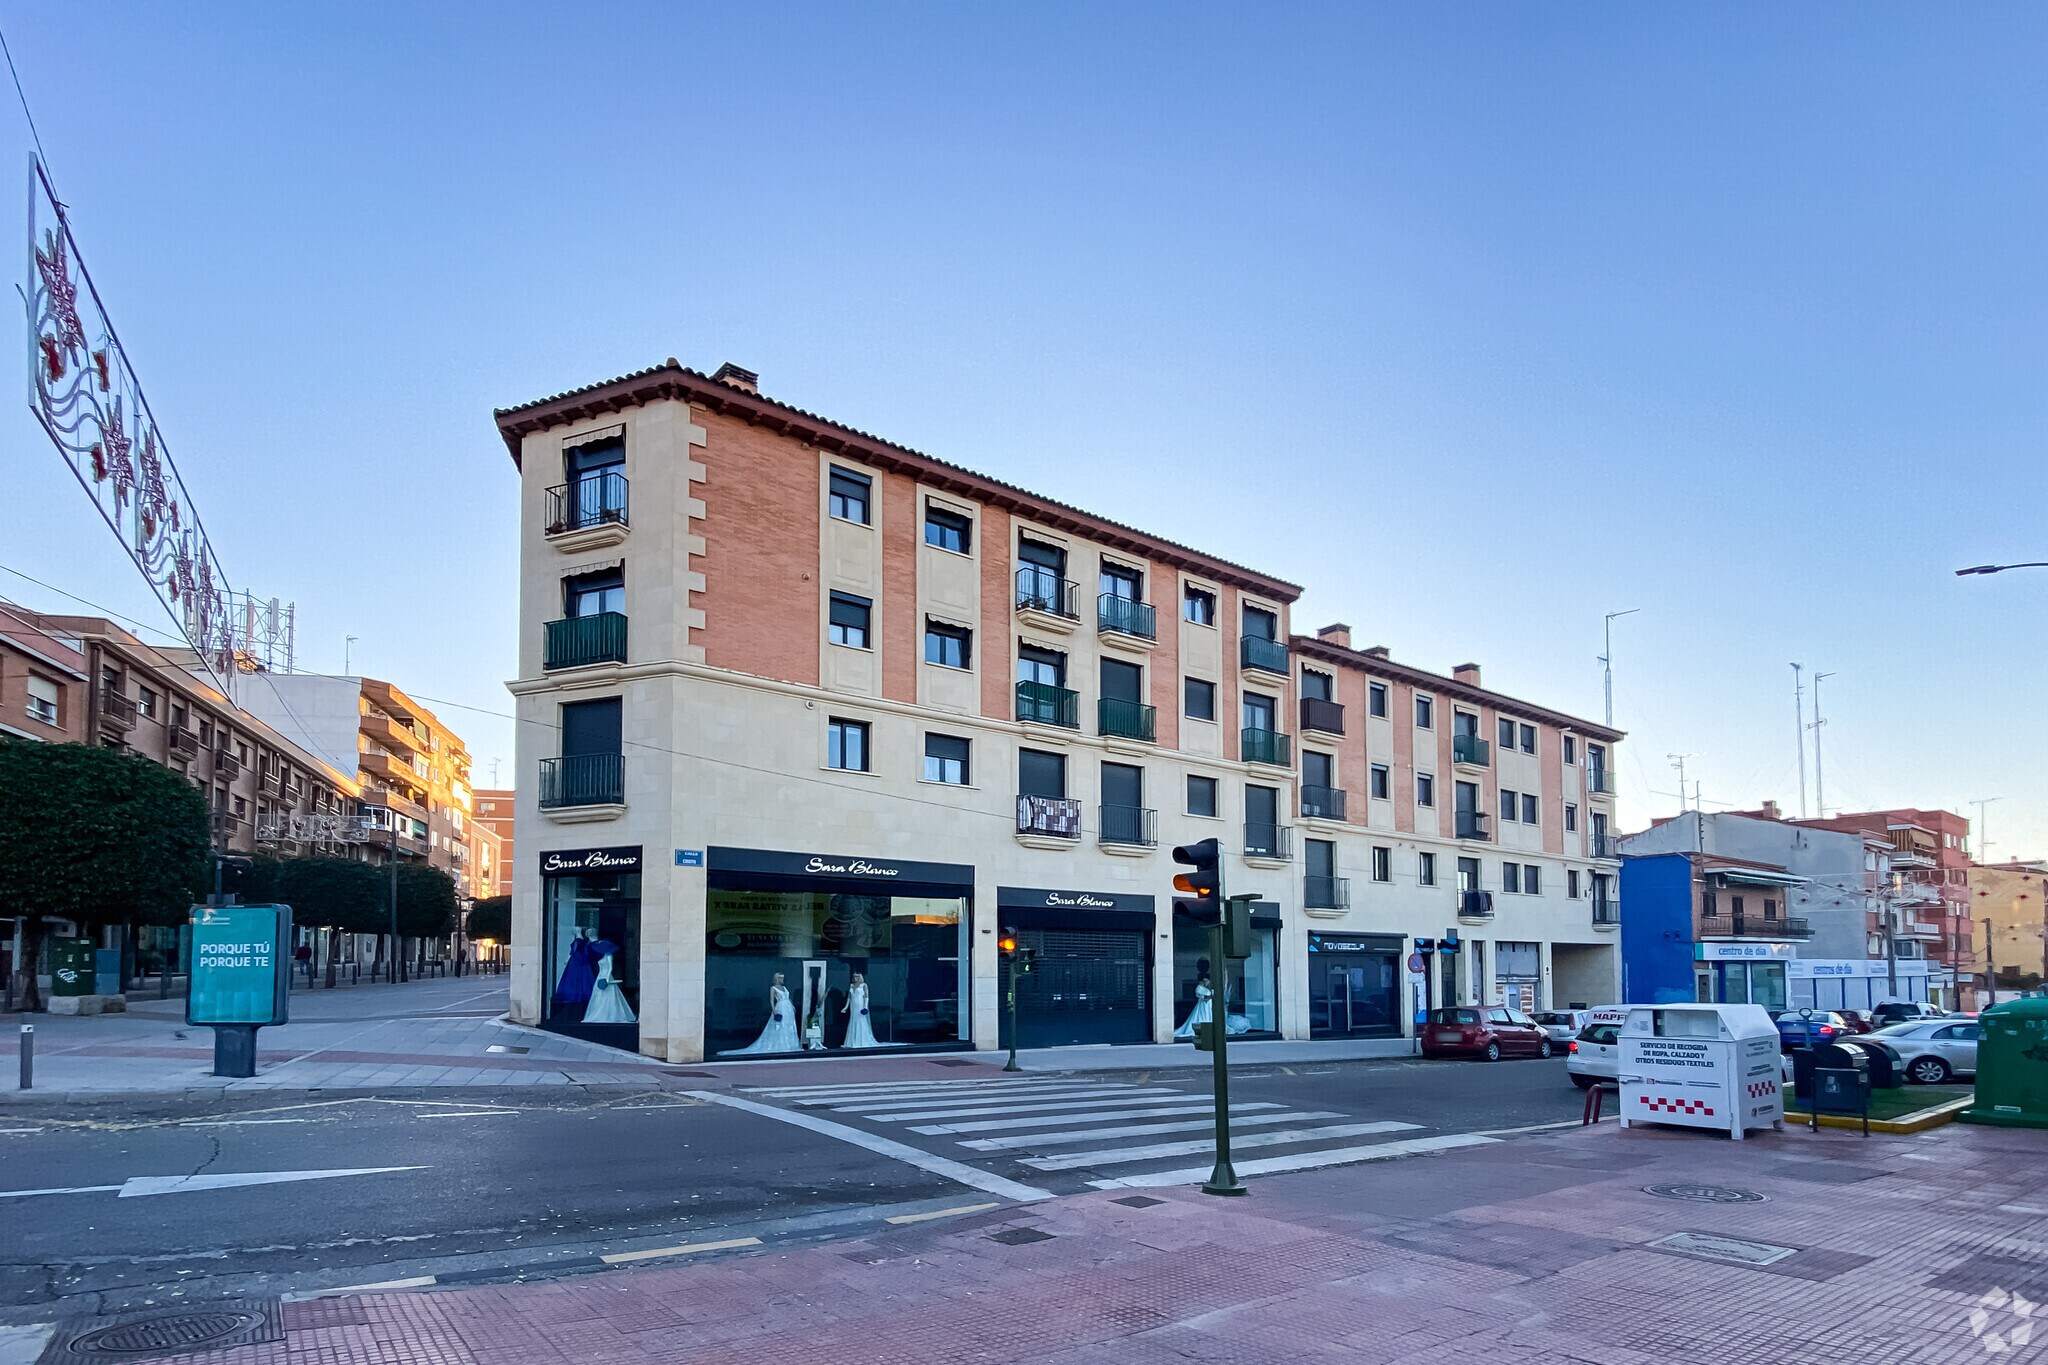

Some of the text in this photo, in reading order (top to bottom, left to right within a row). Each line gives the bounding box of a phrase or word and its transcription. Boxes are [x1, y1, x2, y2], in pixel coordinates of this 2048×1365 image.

[544, 851, 637, 871] Sara Blanco
[805, 857, 899, 876] Sara Blanco
[1045, 892, 1114, 907] Sara Blanco
[200, 941, 270, 955] PORQUE TÚ
[1718, 946, 1742, 955] centro
[1744, 946, 1753, 955] de
[200, 956, 269, 968] PORQUE TE
[1640, 1042, 1667, 1050] SERVICIO
[1677, 1043, 1708, 1051] RECOGIDA
[1671, 1051, 1700, 1059] CALZADO
[1686, 1060, 1715, 1068] TEXTILES
